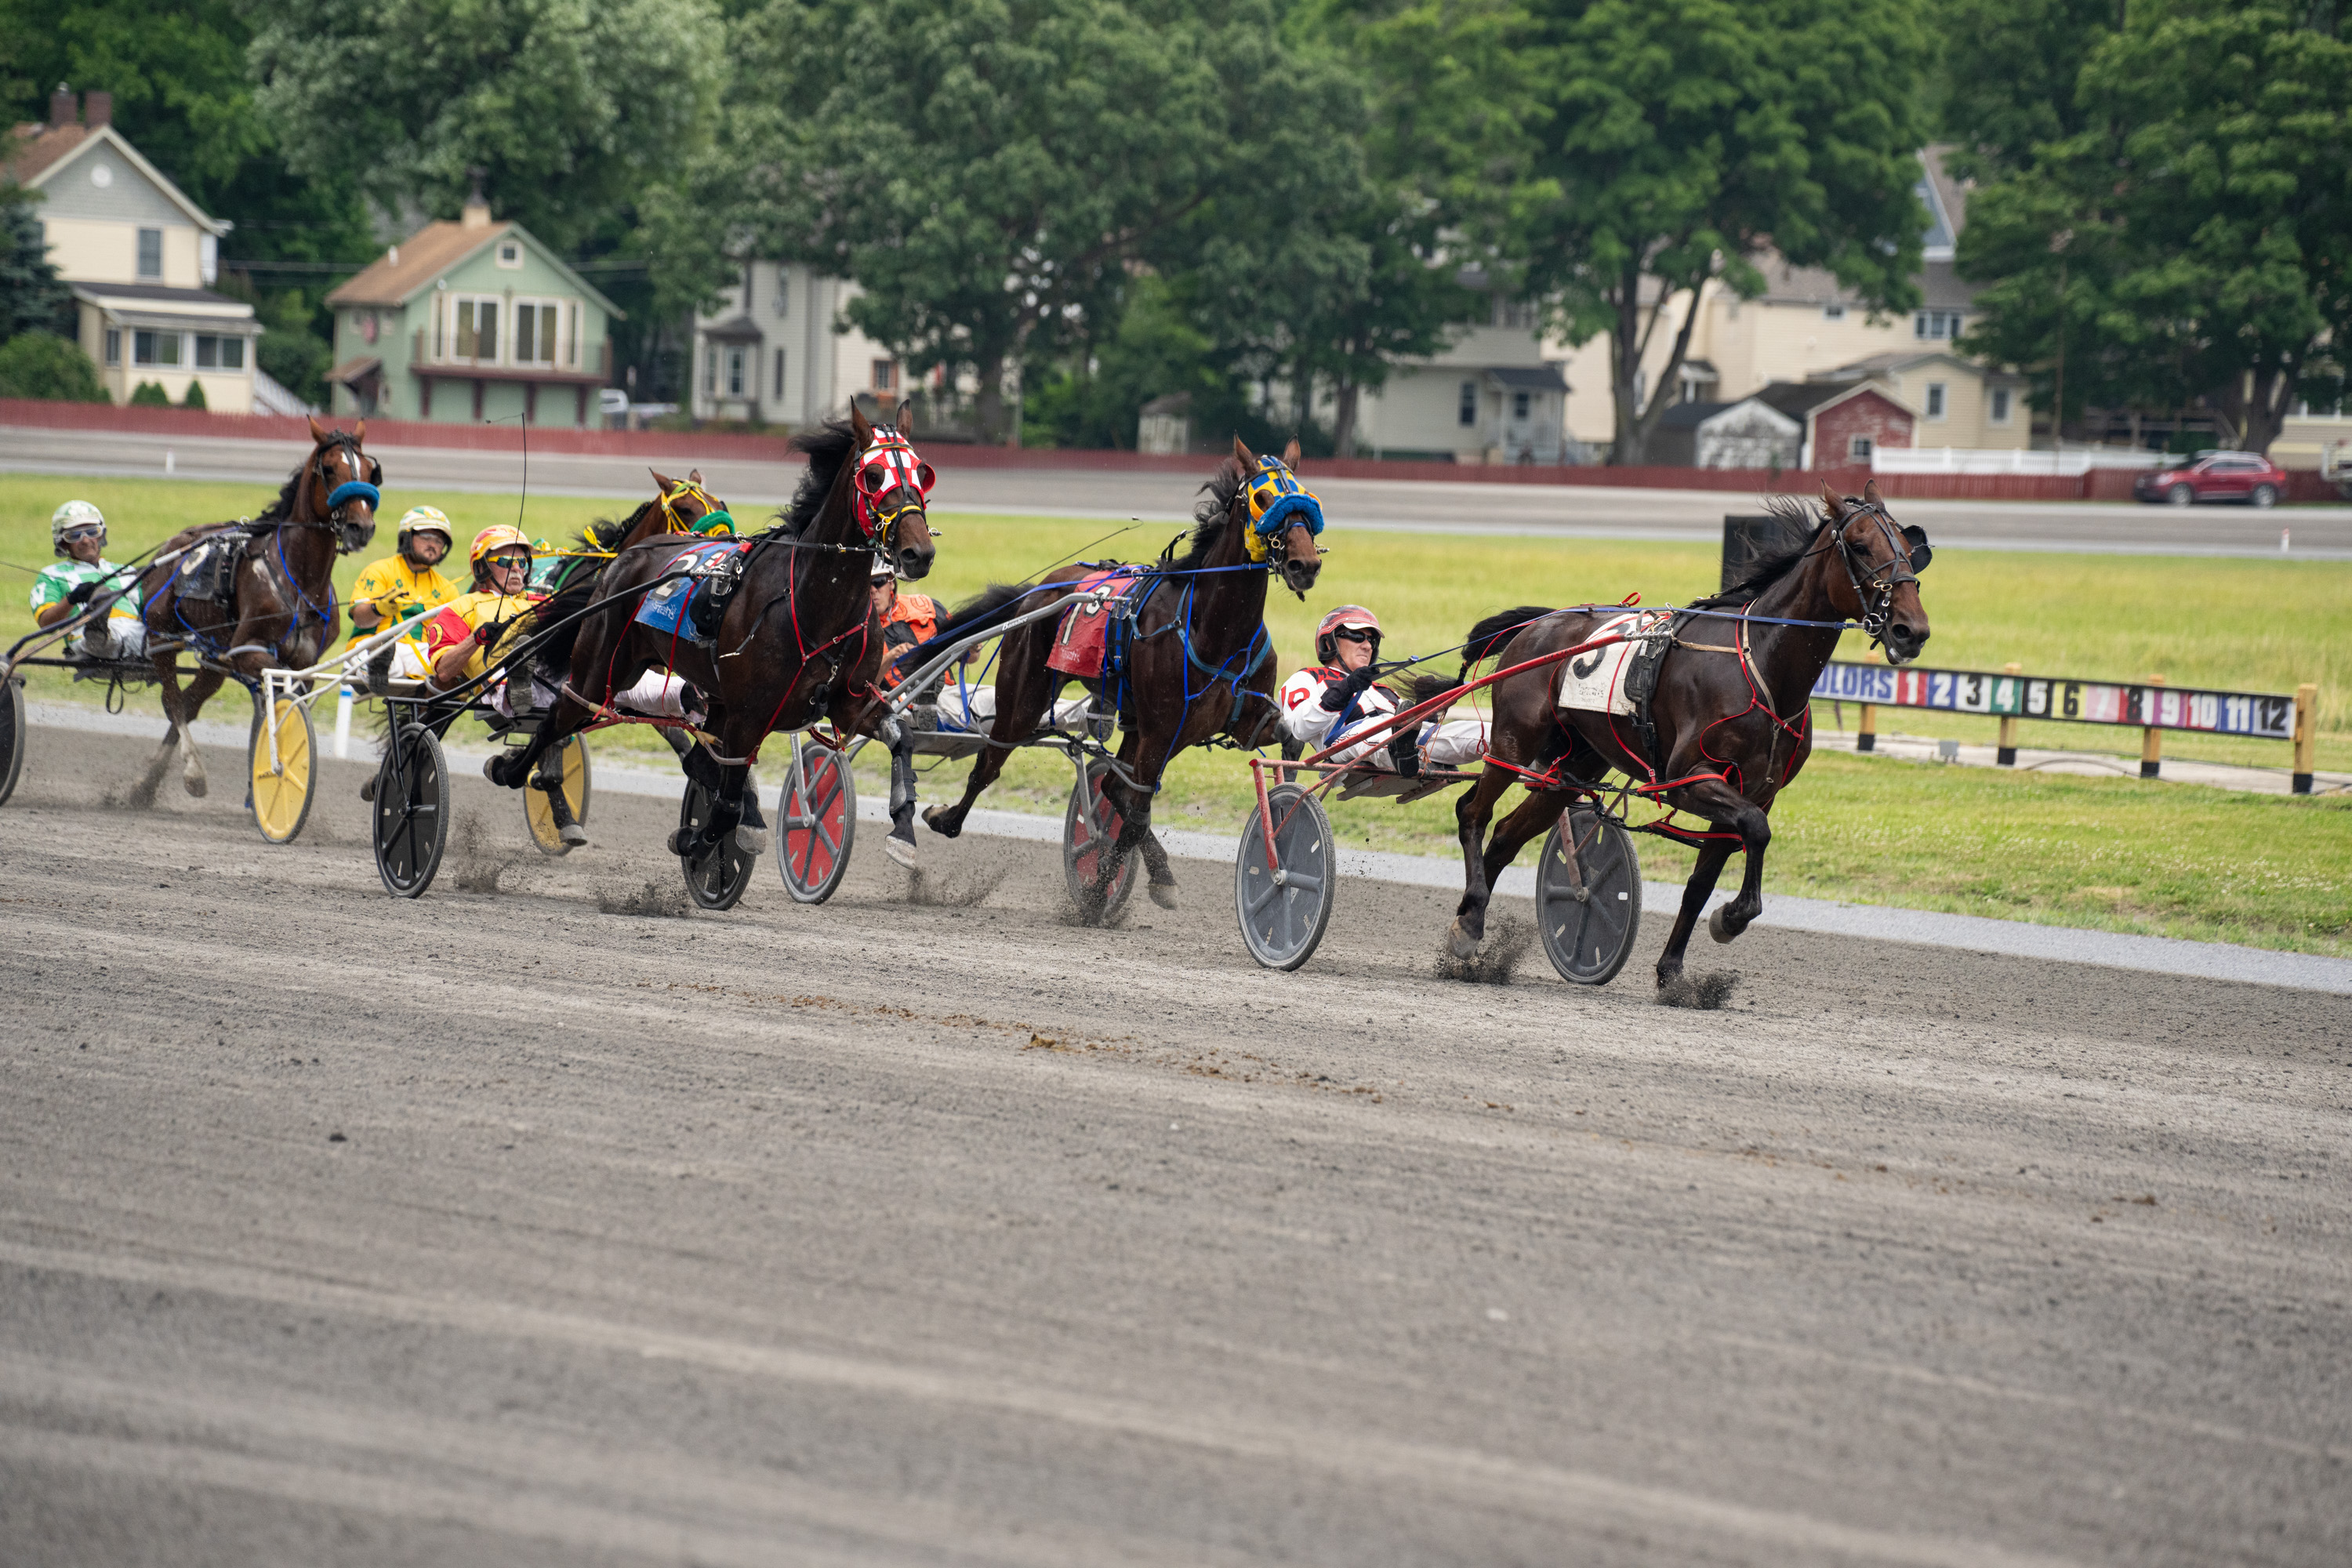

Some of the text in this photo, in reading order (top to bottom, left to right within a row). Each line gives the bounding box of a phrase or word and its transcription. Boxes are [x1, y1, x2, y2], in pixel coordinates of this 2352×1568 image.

[1002, 616, 1028, 632] Banshee
[1573, 623, 1631, 680] 3
[1905, 670, 1919, 705] 1
[1932, 672, 1952, 706] 2
[1965, 673, 1982, 706] 3
[1995, 677, 2015, 712] 4
[2027, 680, 2049, 714] 5
[2063, 684, 2080, 716] 6
[2096, 686, 2113, 719] 7
[2126, 687, 2144, 722] 8
[2160, 690, 2180, 726] 9
[2188, 693, 2218, 729] 10
[2227, 695, 2251, 731] 11
[2259, 698, 2286, 731] 12
